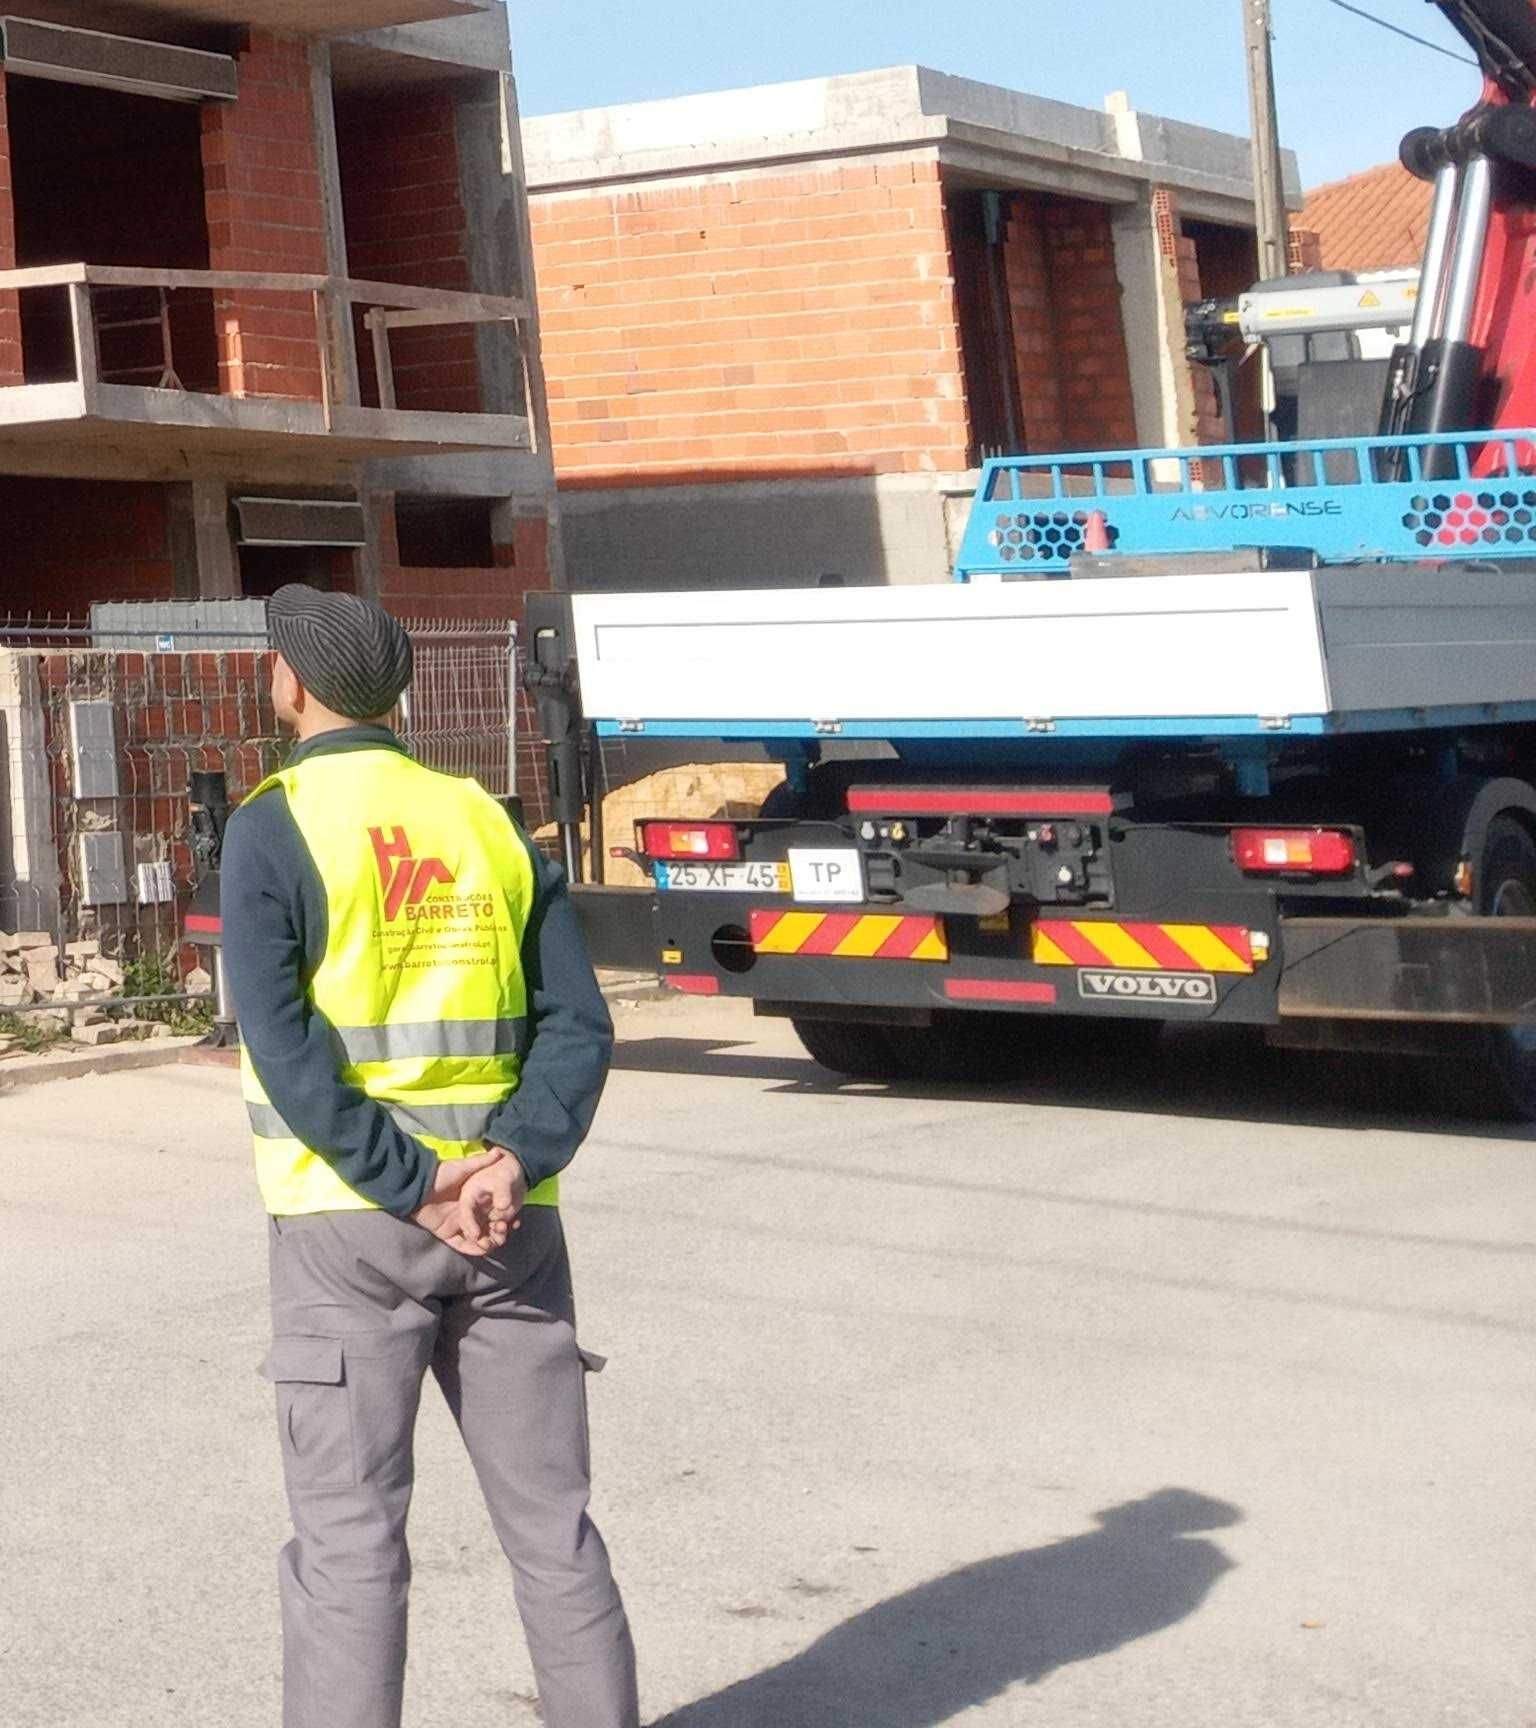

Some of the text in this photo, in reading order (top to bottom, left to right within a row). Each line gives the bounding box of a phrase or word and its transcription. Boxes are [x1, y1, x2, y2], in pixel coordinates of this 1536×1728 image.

[670, 863, 698, 887] 25
[705, 863, 736, 887] XF
[746, 864, 775, 888] 45
[808, 862, 843, 883] TP
[404, 902, 494, 921] BARRETO
[1083, 974, 1210, 998] VOLVO
